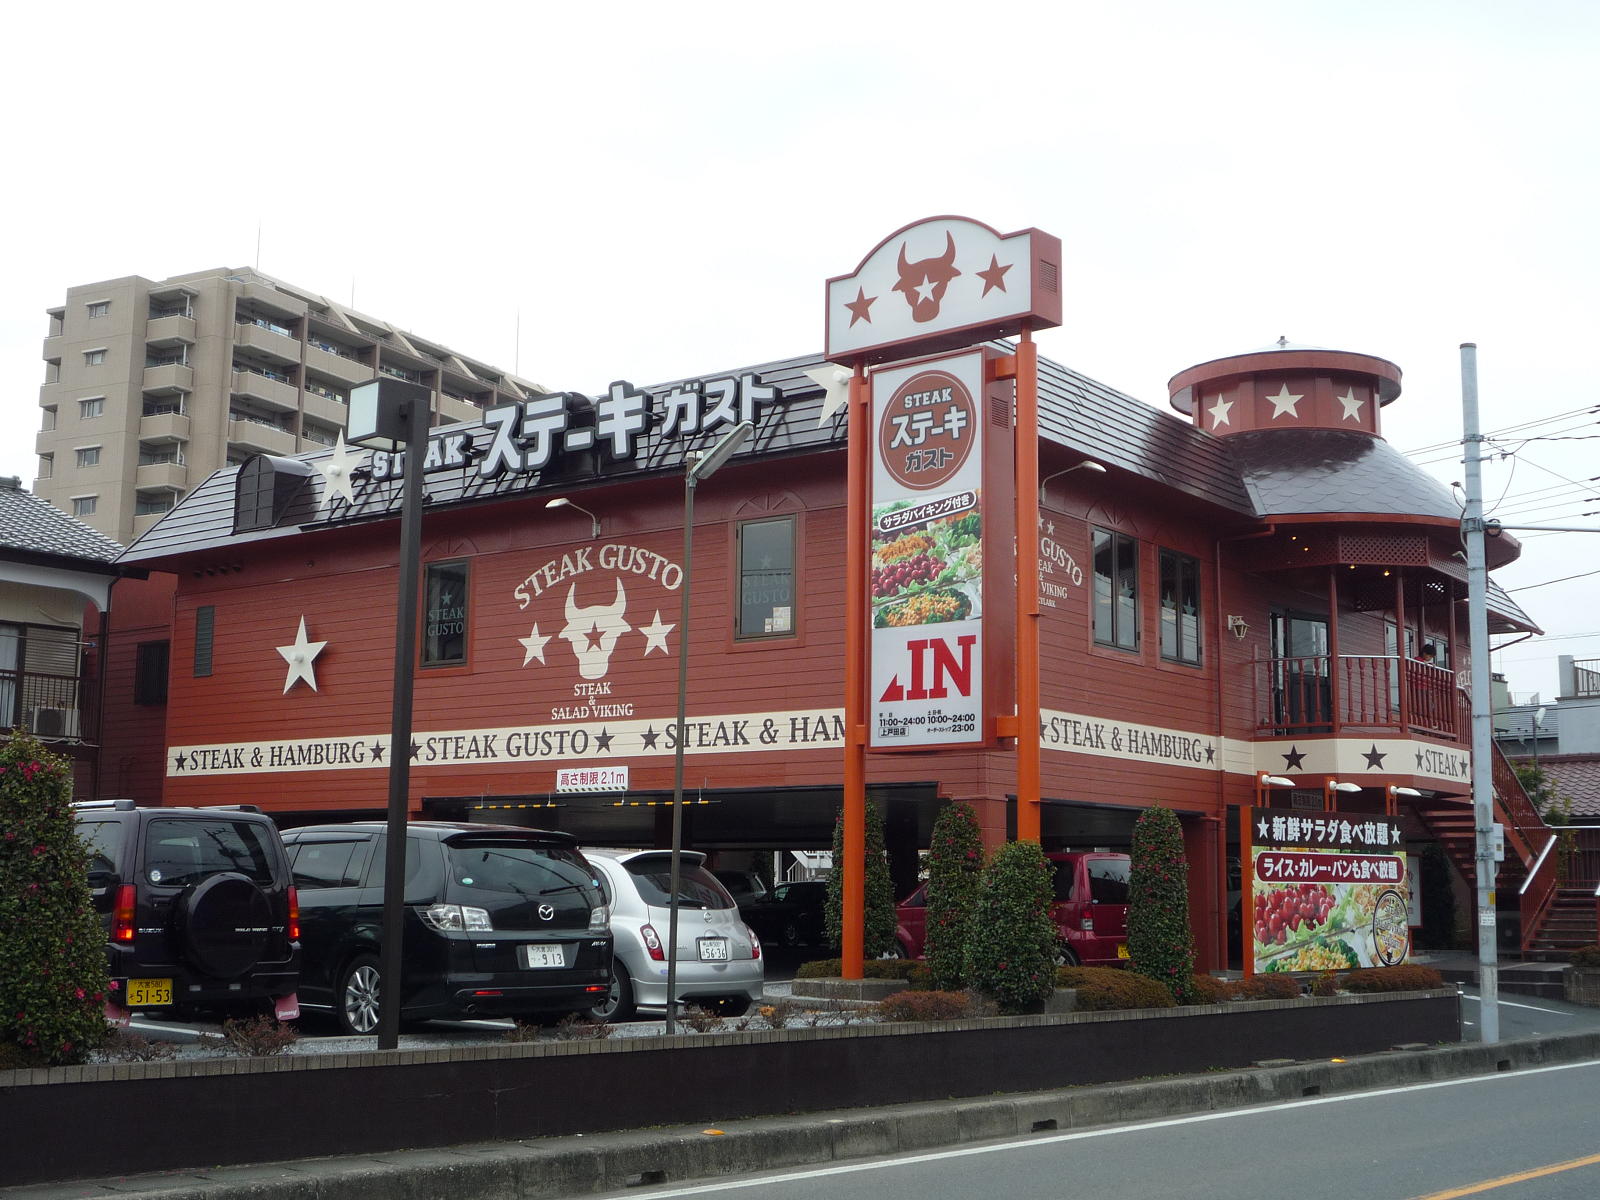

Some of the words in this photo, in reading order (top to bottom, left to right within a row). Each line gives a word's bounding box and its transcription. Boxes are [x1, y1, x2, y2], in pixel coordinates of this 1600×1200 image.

[904, 387, 952, 409] STEAK
[890, 405, 968, 450] ステーキ
[372, 433, 467, 480] STAK
[904, 447, 954, 474] ガスト
[882, 493, 971, 529] サラダバイキング付き
[1038, 559, 1054, 574] EAK
[1040, 536, 1084, 586] GUSTO
[513, 546, 595, 611] STEAK
[598, 543, 685, 591] GUSTO
[1040, 581, 1068, 600] VIKING
[428, 606, 465, 622] STEAK
[427, 621, 464, 637] GUSTO
[906, 634, 977, 701] IN
[573, 681, 612, 697] STEAK
[587, 695, 597, 706] &
[551, 704, 590, 721] SALAD
[591, 702, 634, 718] VIKING
[664, 720, 751, 750] STEAK
[758, 717, 780, 746] &
[951, 723, 975, 733] 23:00
[1049, 716, 1106, 750] STEAK
[1111, 726, 1122, 752] &
[1127, 728, 1202, 763] HAMBURG
[189, 747, 245, 771] STEAK
[250, 746, 263, 768] &
[269, 741, 365, 767] HAMBURG
[425, 733, 498, 762] STEAK
[505, 729, 589, 758] GUSTO
[1425, 748, 1459, 778] STEAK
[560, 771, 599, 787] 高さ制限
[600, 770, 625, 785] 2.1m
[1272, 815, 1389, 846] 新鮮サラダ食べ放題
[136, 989, 170, 1003] 51-53
